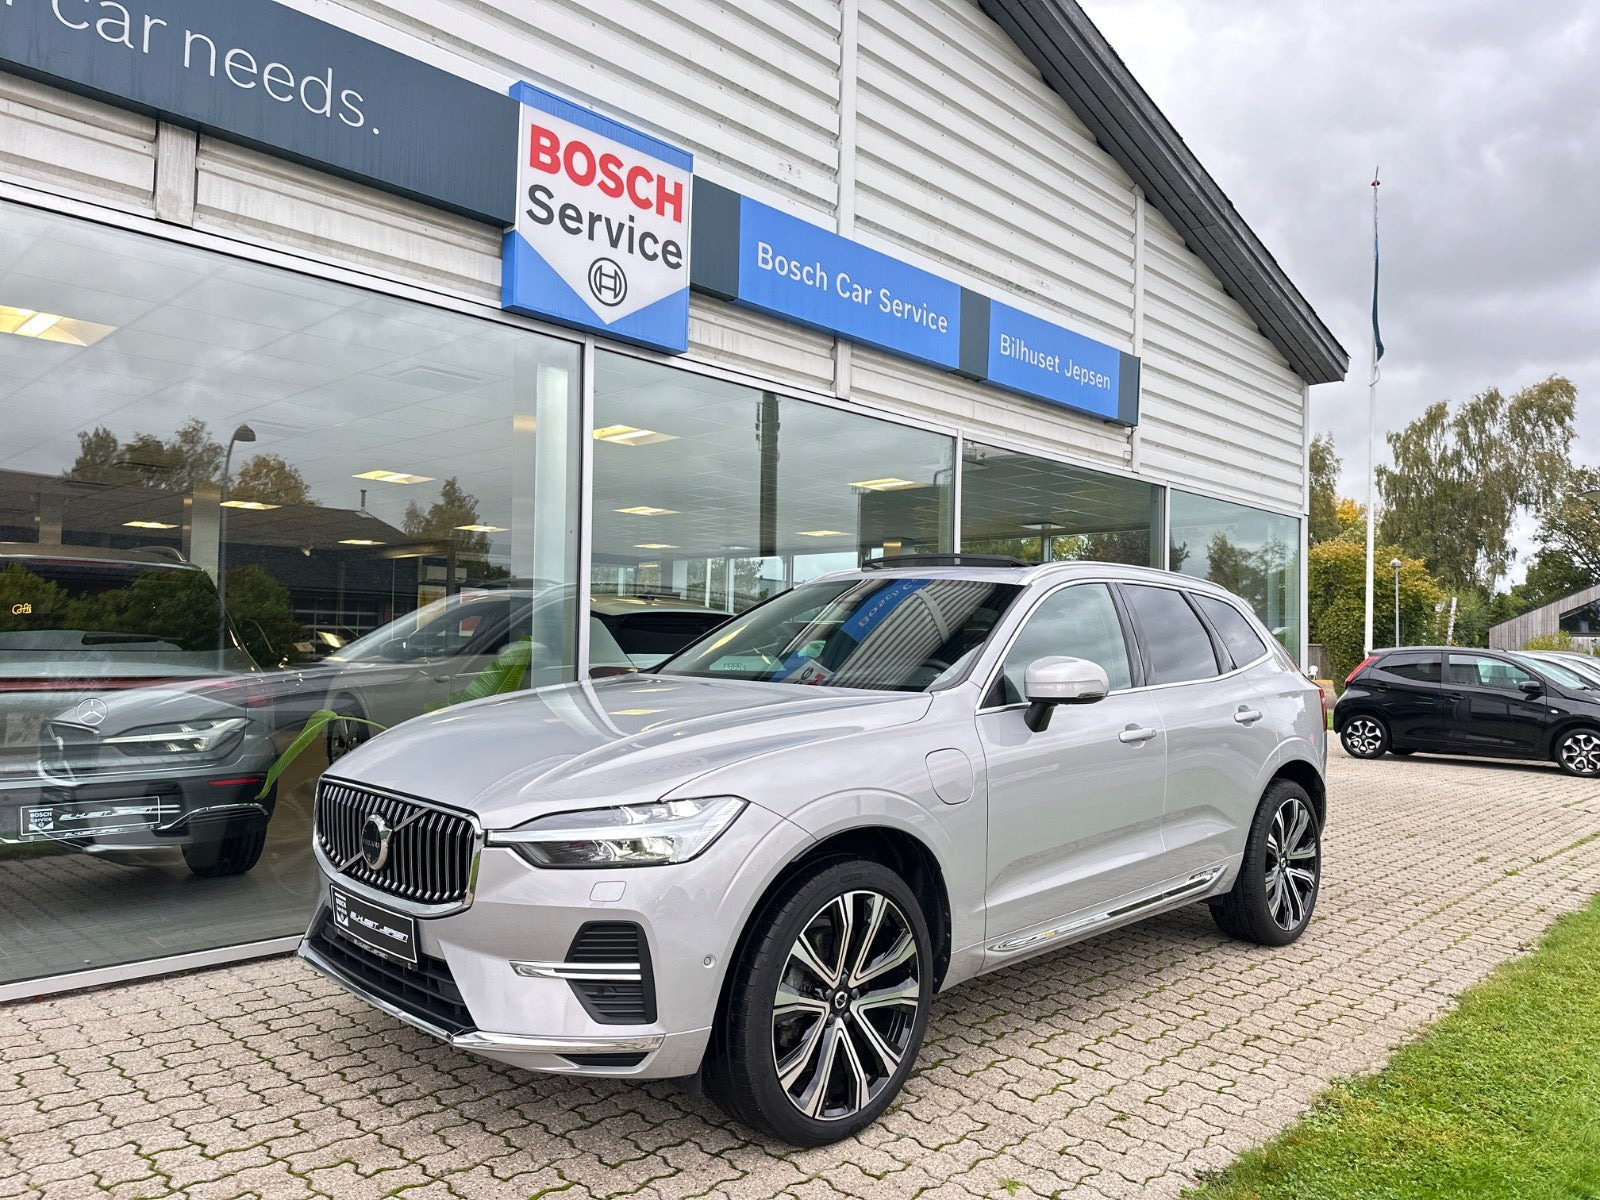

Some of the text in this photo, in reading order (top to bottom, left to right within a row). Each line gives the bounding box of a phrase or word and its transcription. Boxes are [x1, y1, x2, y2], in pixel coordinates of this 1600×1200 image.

[52, 0, 380, 135] car needs.
[530, 123, 683, 224] BOSCH
[526, 184, 683, 270] Service
[757, 240, 949, 334] Bosch Car Service
[1000, 333, 1111, 391] Bilhuset Jepsen
